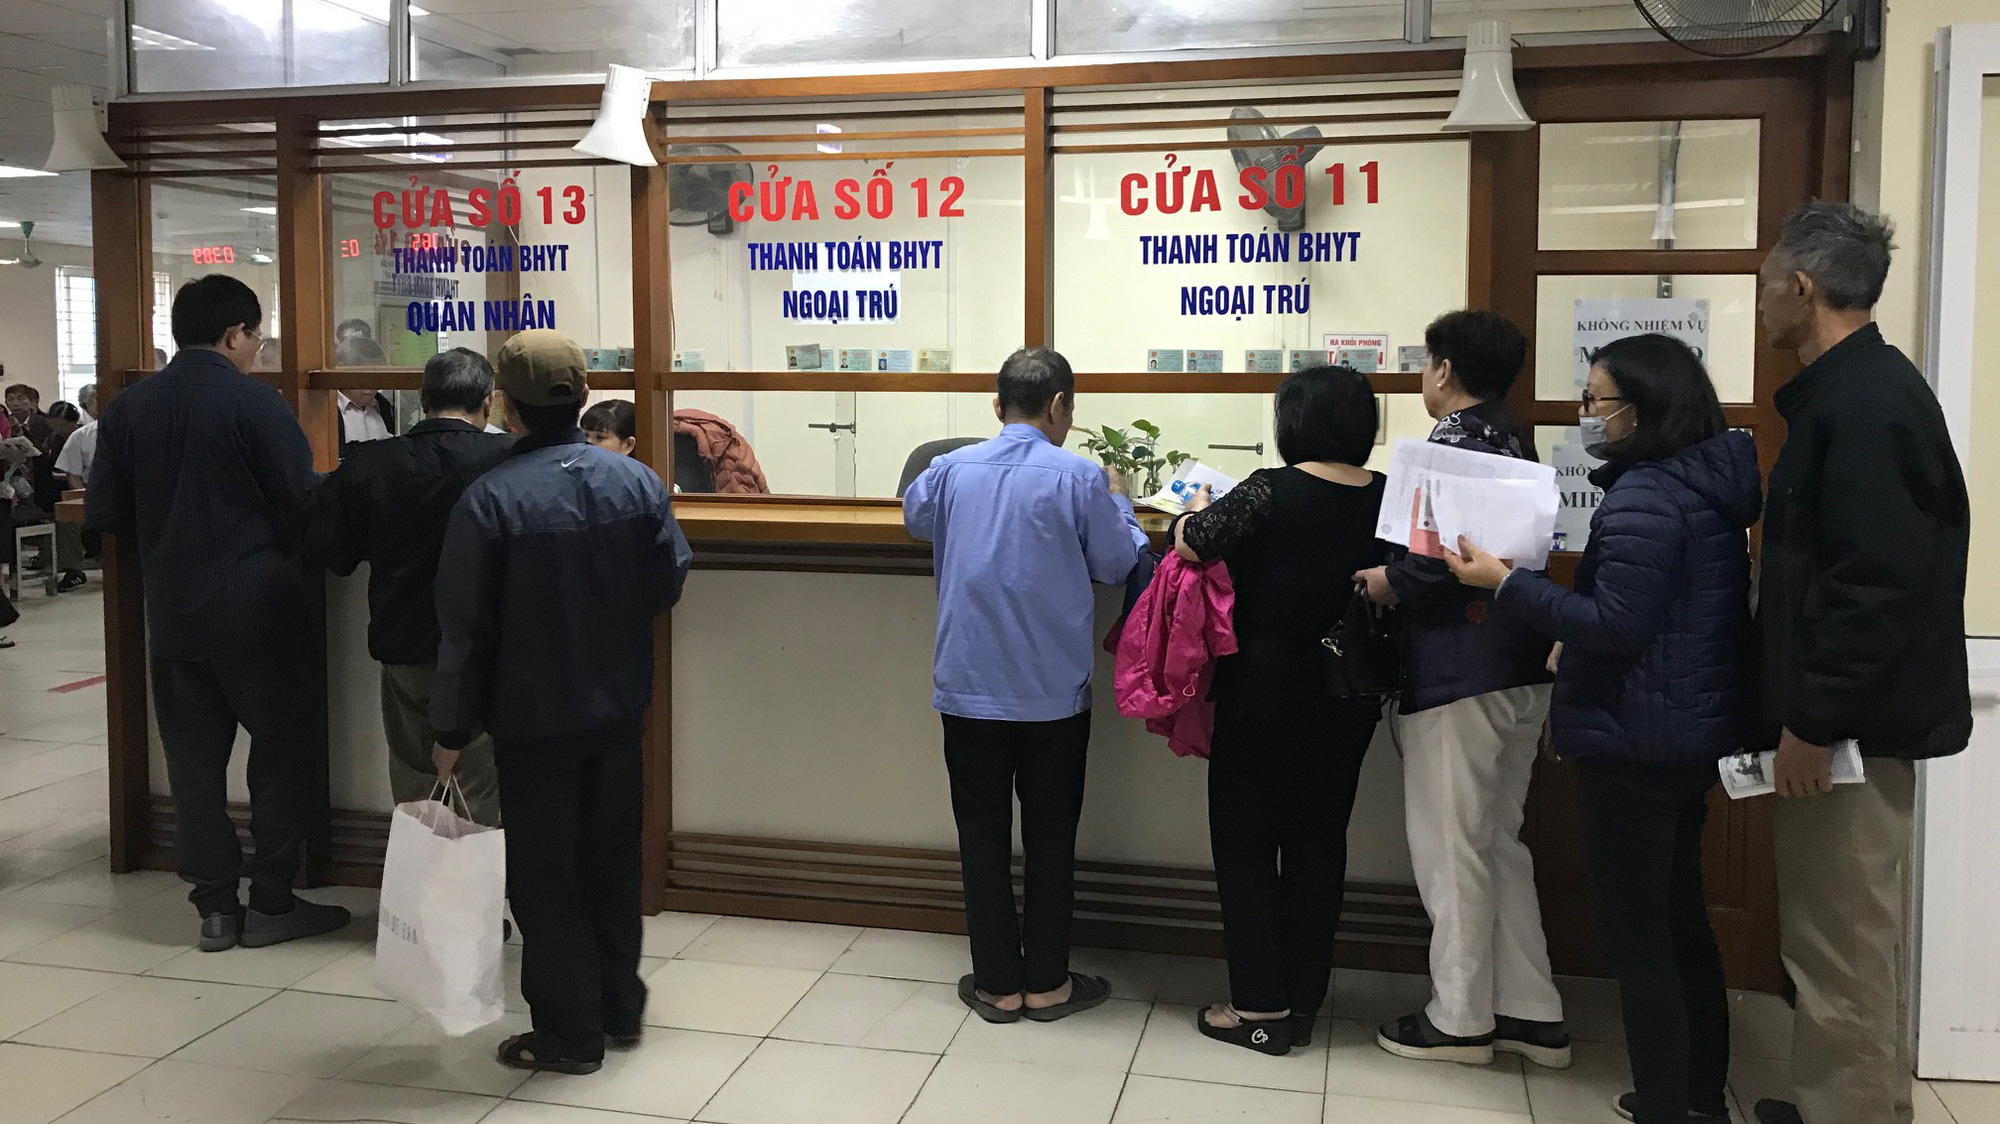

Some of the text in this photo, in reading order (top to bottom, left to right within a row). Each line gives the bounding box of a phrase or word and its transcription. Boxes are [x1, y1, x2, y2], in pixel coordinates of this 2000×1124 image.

[373, 170, 586, 229] CỬA SỐ 13
[728, 161, 965, 222] CỬA SỐ 12
[1120, 146, 1379, 216] CỬA SỐ 11
[393, 246, 455, 273] THANH
[463, 239, 513, 273] TOÁN
[520, 244, 569, 272] BHYT
[748, 236, 943, 271] THANH TOÁN BHYT
[1140, 226, 1361, 265] THANH TOÁN BHYT
[407, 293, 556, 336] QUÂN NHÂN
[783, 283, 898, 324] NGOẠI TRÚ
[1181, 277, 1310, 321] NGOẠI TRÚ
[1577, 317, 1708, 334] KHÔNG NHIỆM VỤ
